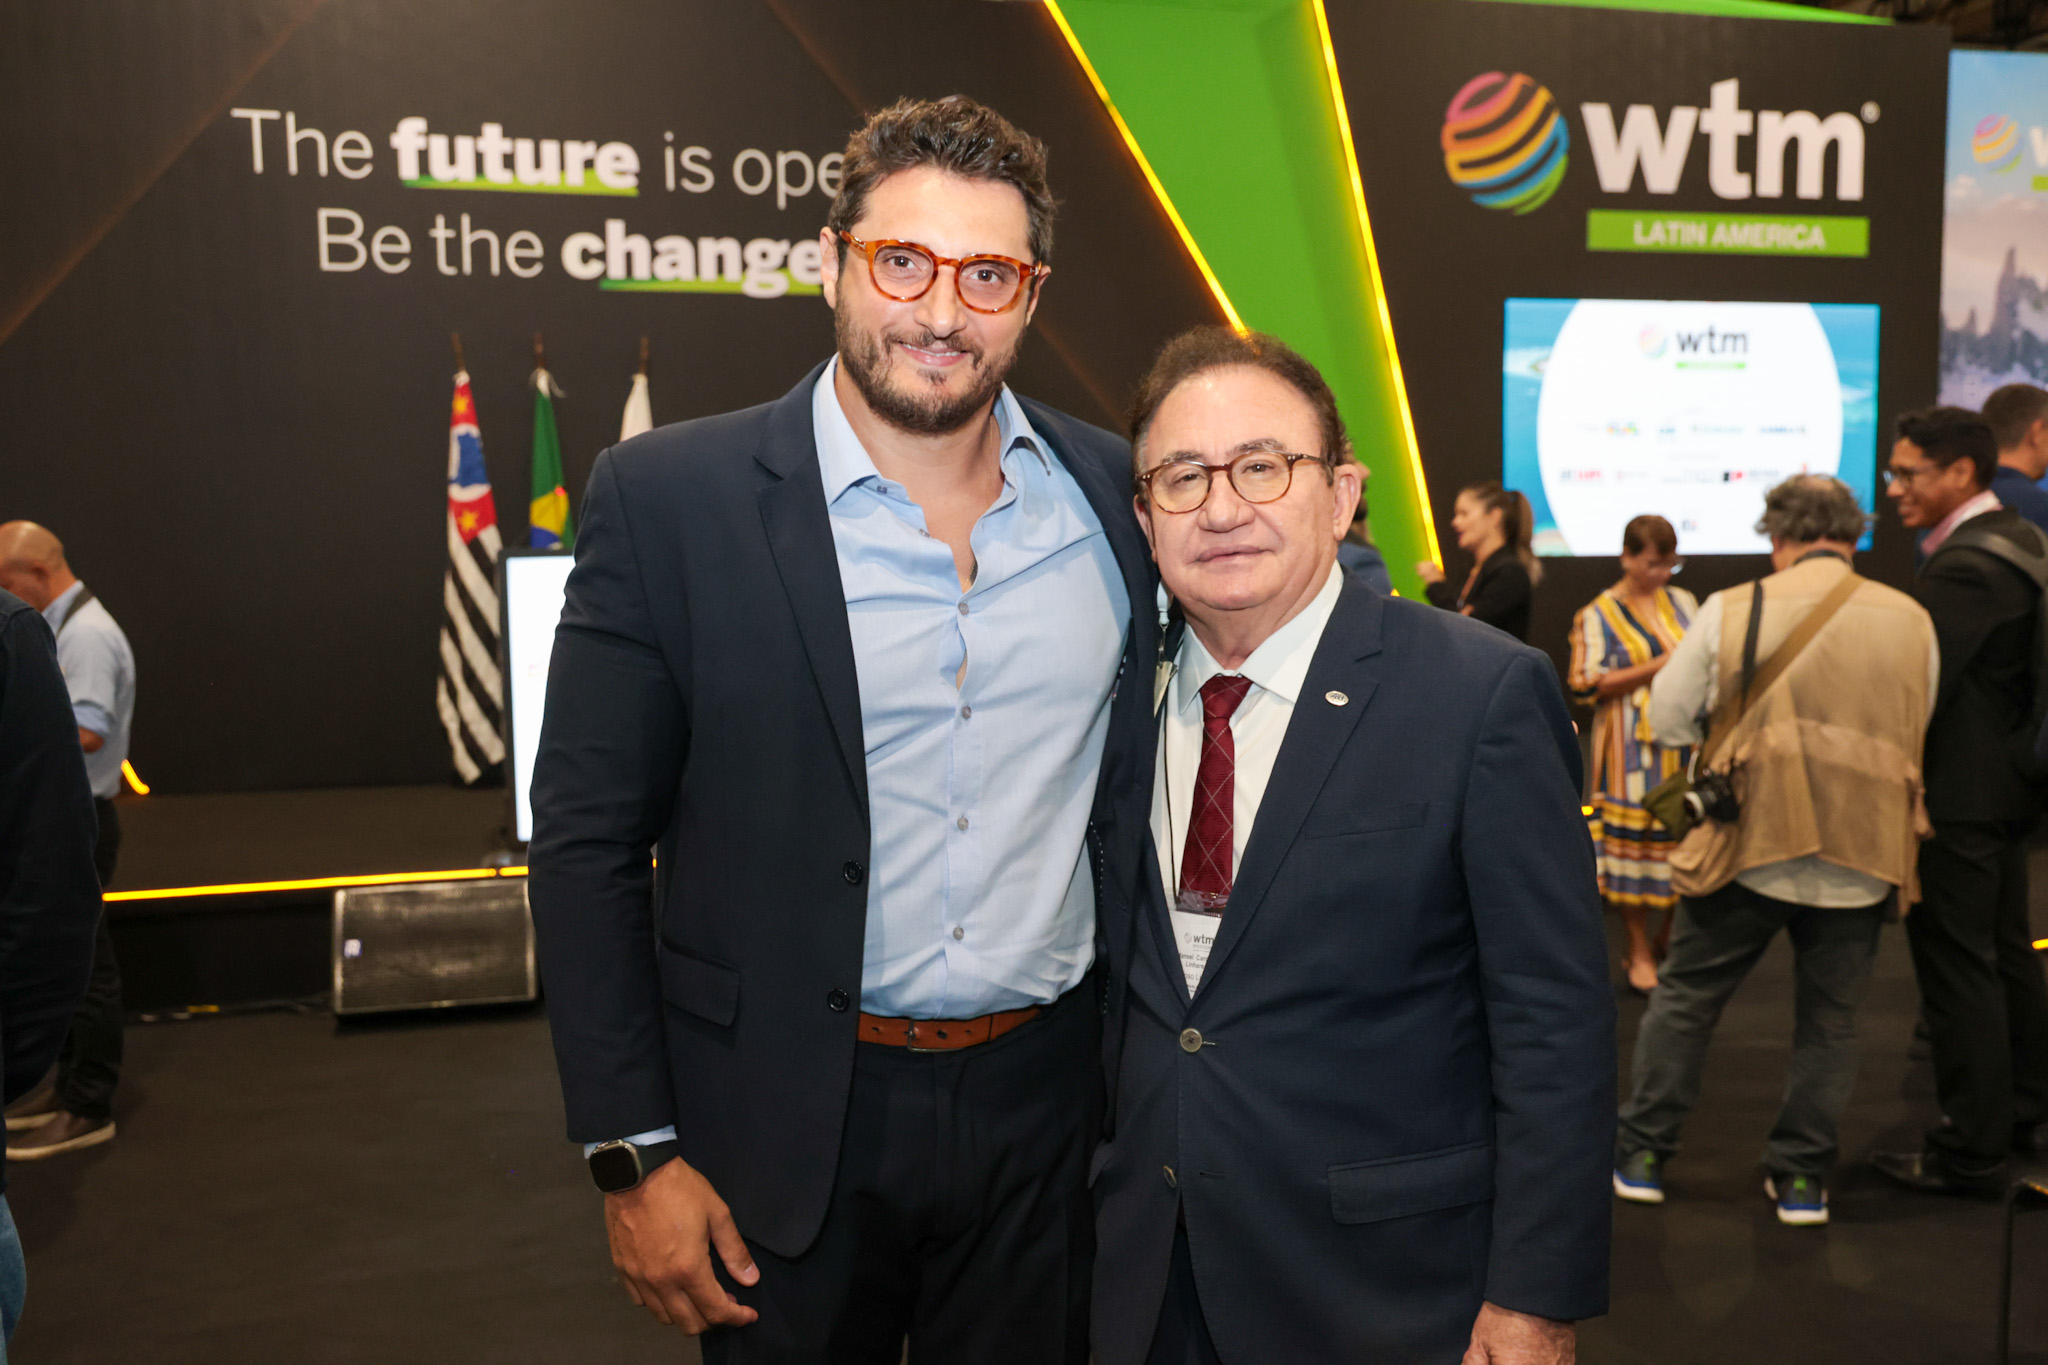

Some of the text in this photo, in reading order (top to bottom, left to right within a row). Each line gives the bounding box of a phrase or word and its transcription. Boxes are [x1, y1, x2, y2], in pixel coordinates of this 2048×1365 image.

[1580, 77, 1865, 201] wtm
[231, 107, 843, 211] The future is ope
[1633, 219, 1827, 250] LATIN AMERICA
[317, 207, 823, 298] Be the change
[1677, 324, 1748, 353] wtm
[1193, 934, 1215, 944] wtm
[1185, 961, 1205, 969] Linhare
